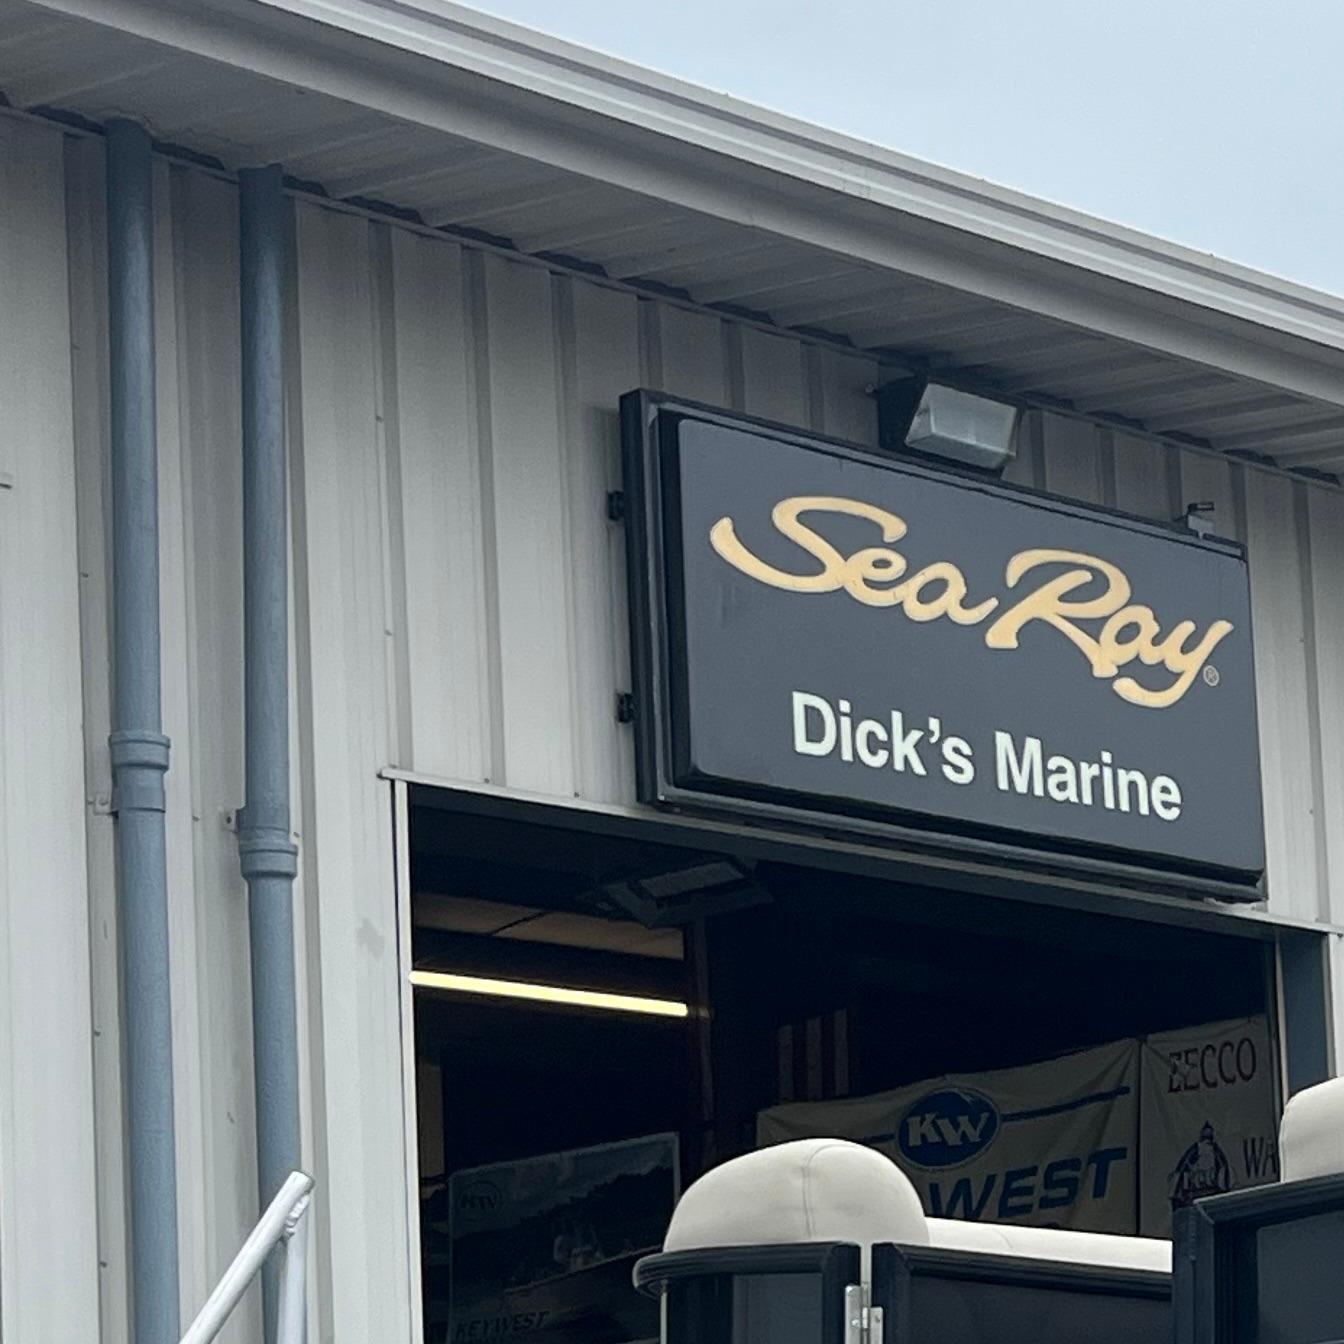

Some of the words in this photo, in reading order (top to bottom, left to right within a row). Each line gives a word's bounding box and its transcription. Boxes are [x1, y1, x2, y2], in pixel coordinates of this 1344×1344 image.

[710, 496, 998, 625] Sea
[985, 548, 1234, 708] Ray
[791, 690, 975, 786] Dick's
[995, 730, 1182, 821] Marine
[906, 1110, 992, 1148] KW
[929, 1146, 1128, 1221] WEST
